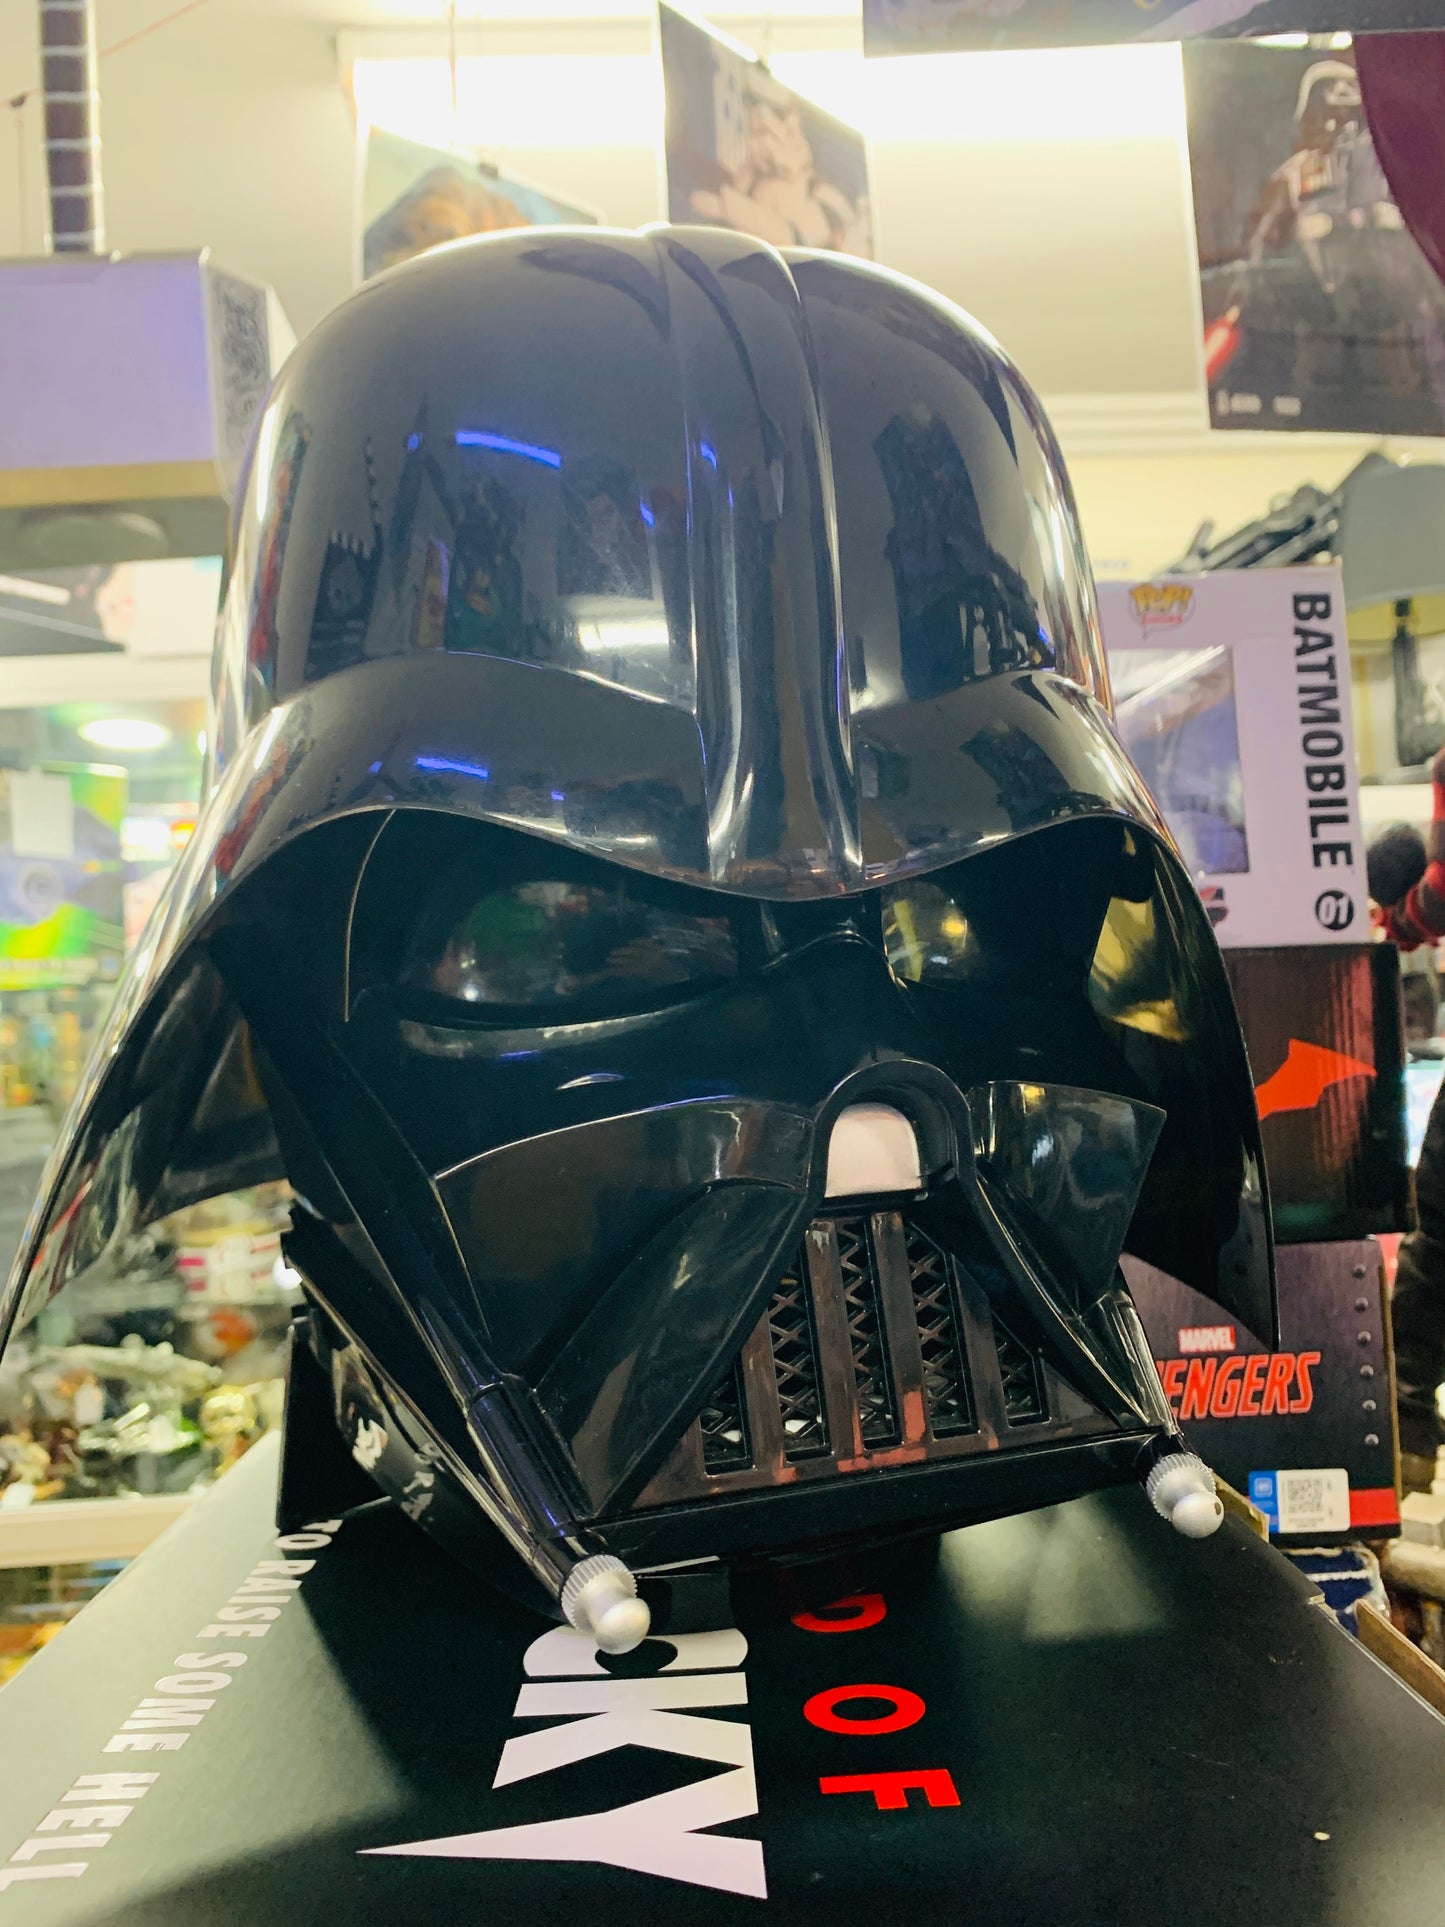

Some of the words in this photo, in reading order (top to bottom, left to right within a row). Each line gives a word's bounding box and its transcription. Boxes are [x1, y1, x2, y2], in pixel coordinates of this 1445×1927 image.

[1292, 593, 1354, 868] BATMOBILE
[1156, 1352, 1321, 1420] ENGERS
[1179, 1327, 1235, 1352] MARVEL
[196, 1559, 317, 1638] RAISE
[102, 1651, 248, 1752] SOME
[804, 1684, 961, 1810] OF
[0, 1772, 160, 1891] HELL
